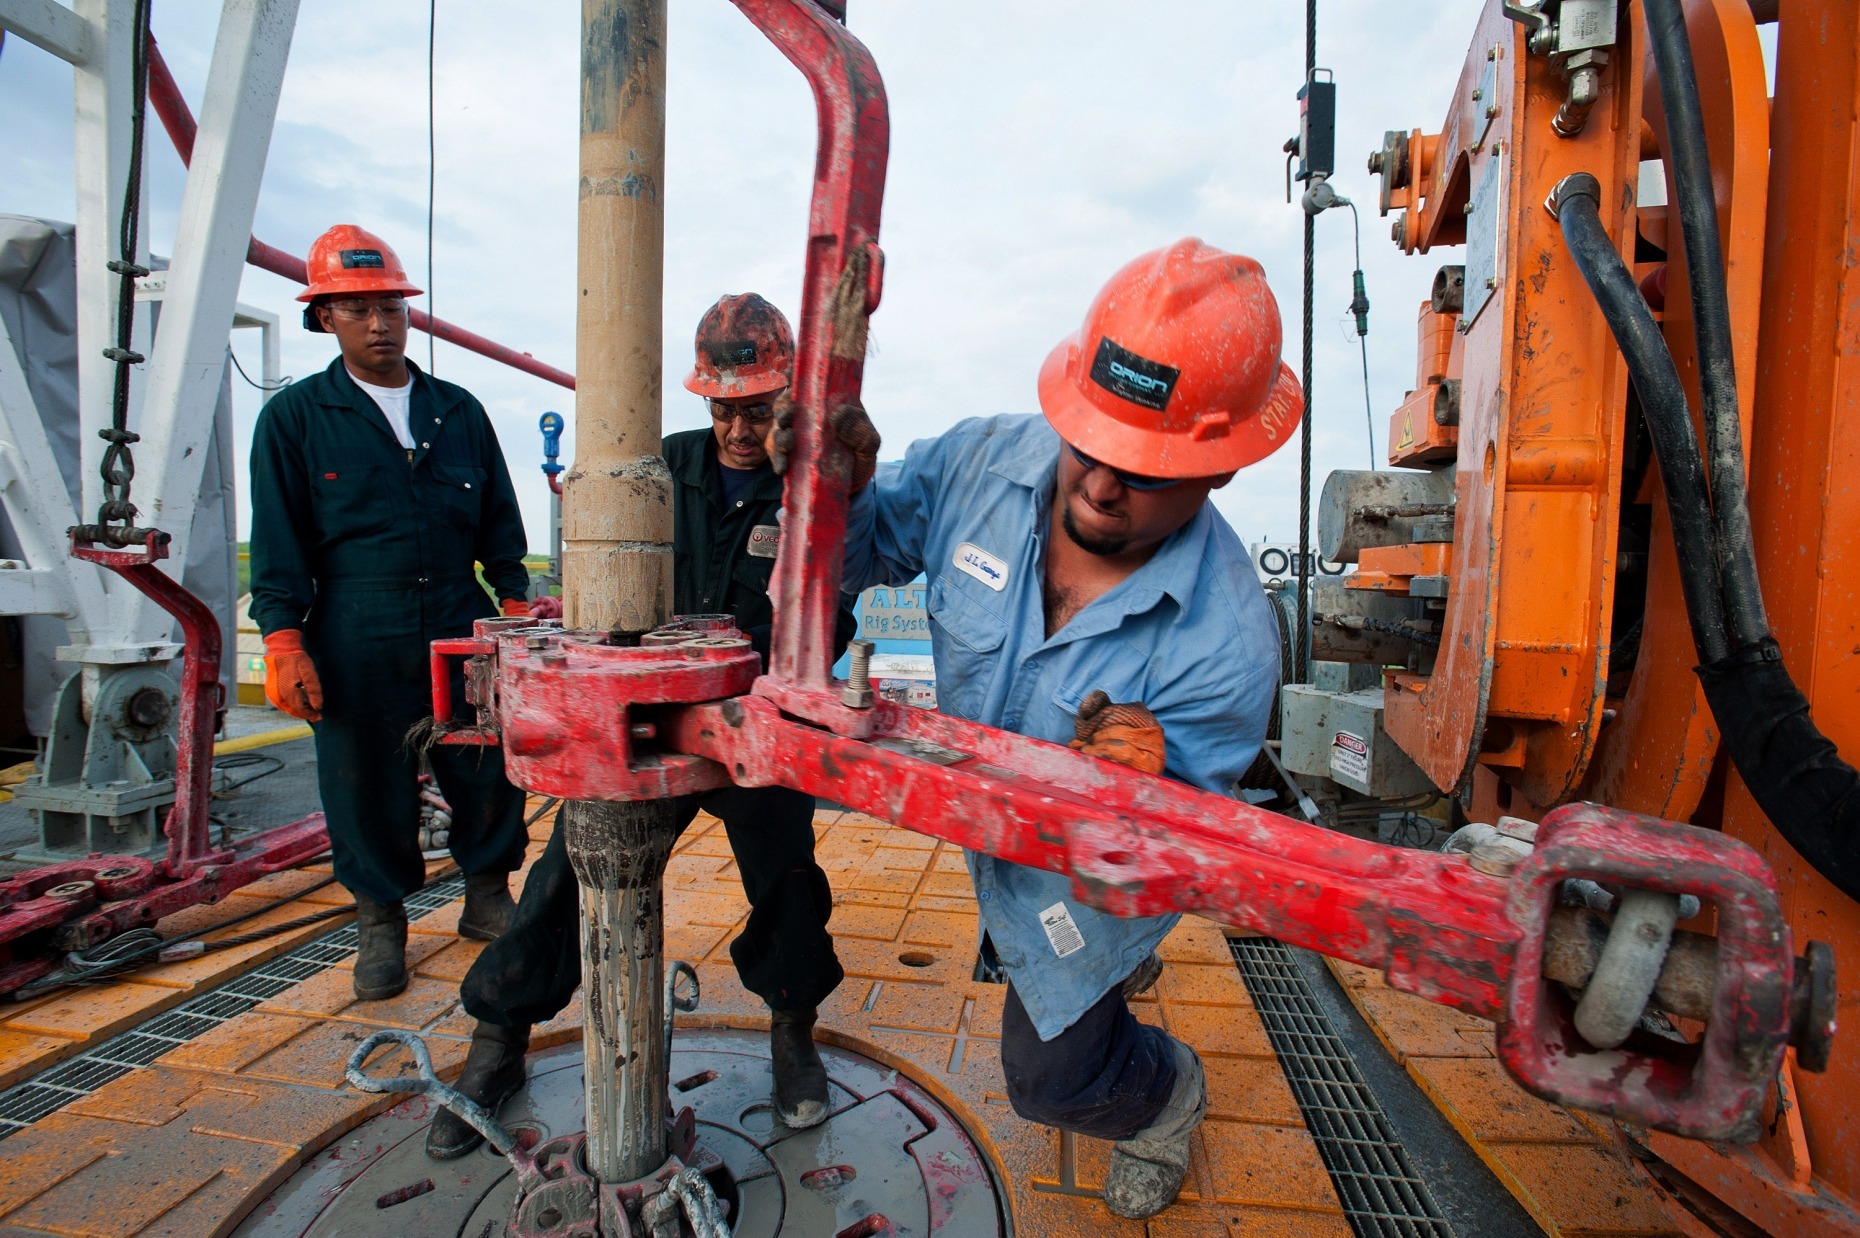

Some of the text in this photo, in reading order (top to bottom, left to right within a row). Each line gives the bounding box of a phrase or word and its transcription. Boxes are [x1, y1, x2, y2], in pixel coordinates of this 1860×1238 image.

[1110, 361, 1168, 393] ORION
[865, 615, 890, 633] Rig
[1340, 736, 1363, 751] DANGER
